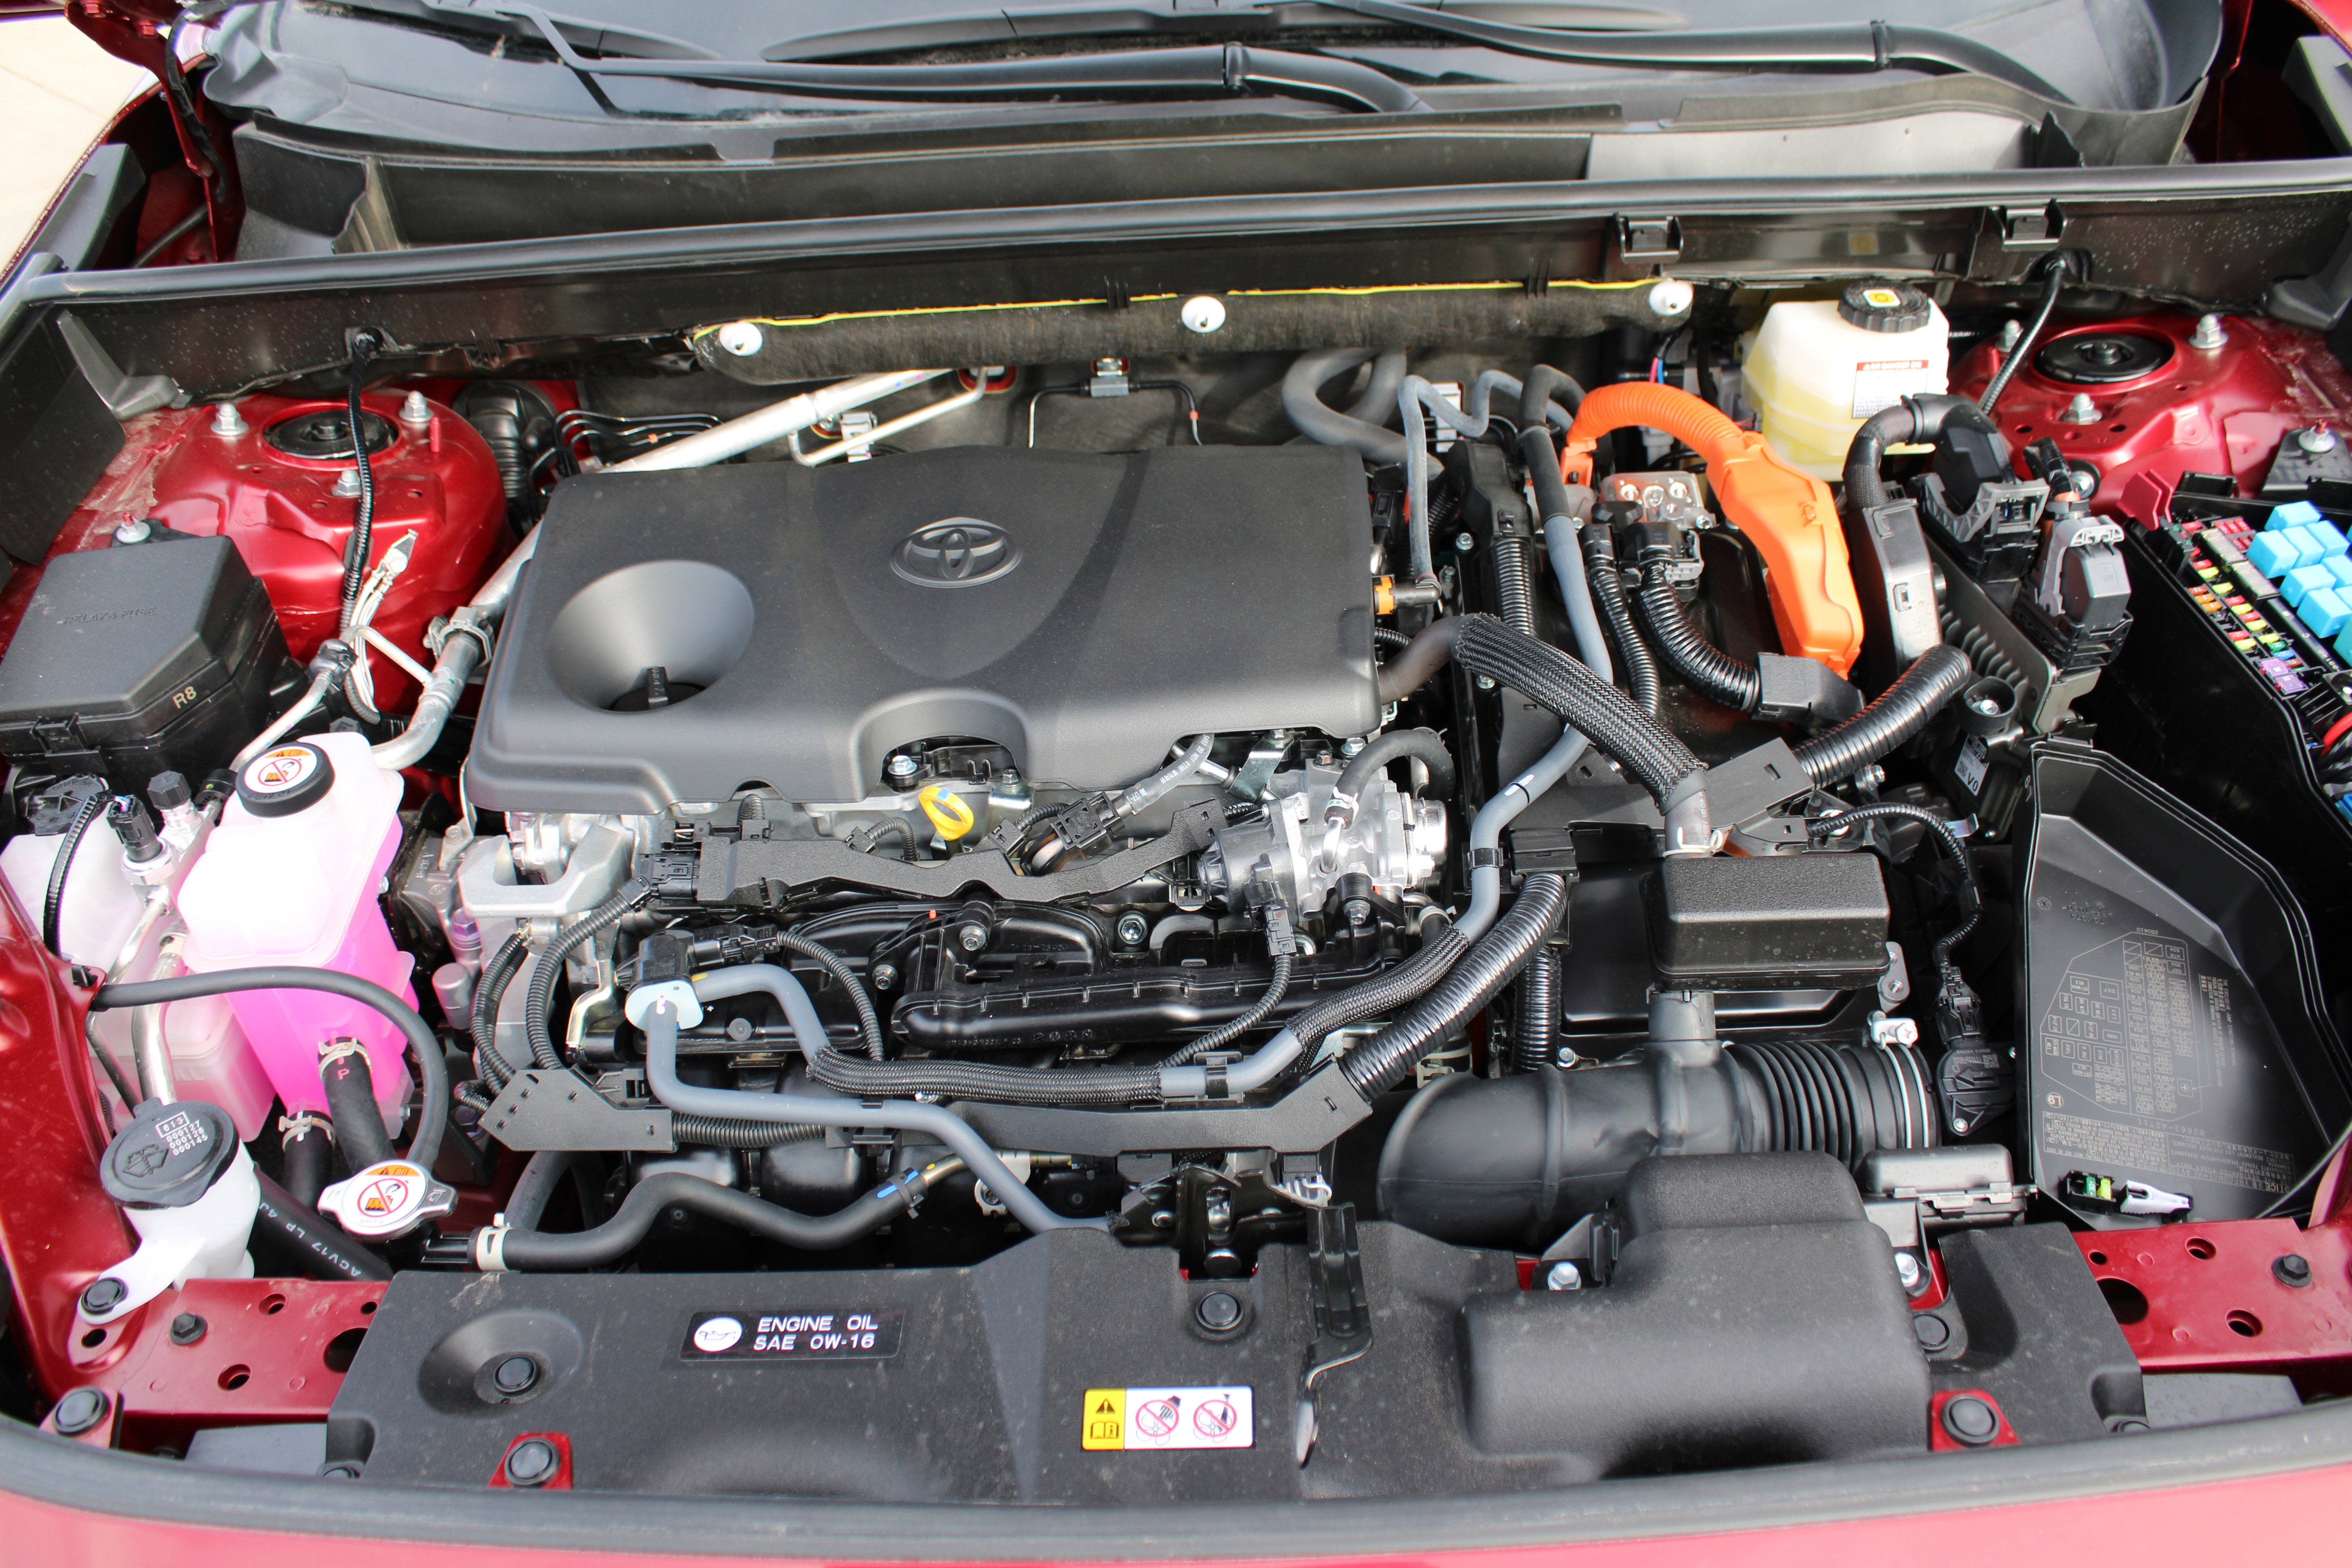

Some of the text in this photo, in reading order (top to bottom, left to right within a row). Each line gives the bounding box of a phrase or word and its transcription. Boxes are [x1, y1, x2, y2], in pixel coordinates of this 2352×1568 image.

[172, 686, 197, 709] R8
[1189, 752, 1200, 763] NOT
[1196, 745, 1205, 754] DO
[1177, 760, 1191, 772] KINK
[2047, 1094, 2061, 1106] L9
[163, 1116, 184, 1132] e13
[166, 1119, 200, 1143] 000127
[2138, 1119, 2205, 1136] 82662-42711
[170, 1127, 205, 1149] 000128
[173, 1133, 209, 1156] 000145
[2170, 1166, 2189, 1176] AVIS
[2219, 1169, 2260, 1180] DESIGNATED
[2265, 1183, 2290, 1194] OTICE
[285, 1222, 306, 1239] LP
[311, 1241, 362, 1277] ACV17
[757, 1314, 878, 1333] ENGINE OIL
[753, 1332, 876, 1351] SAE 0W-16
